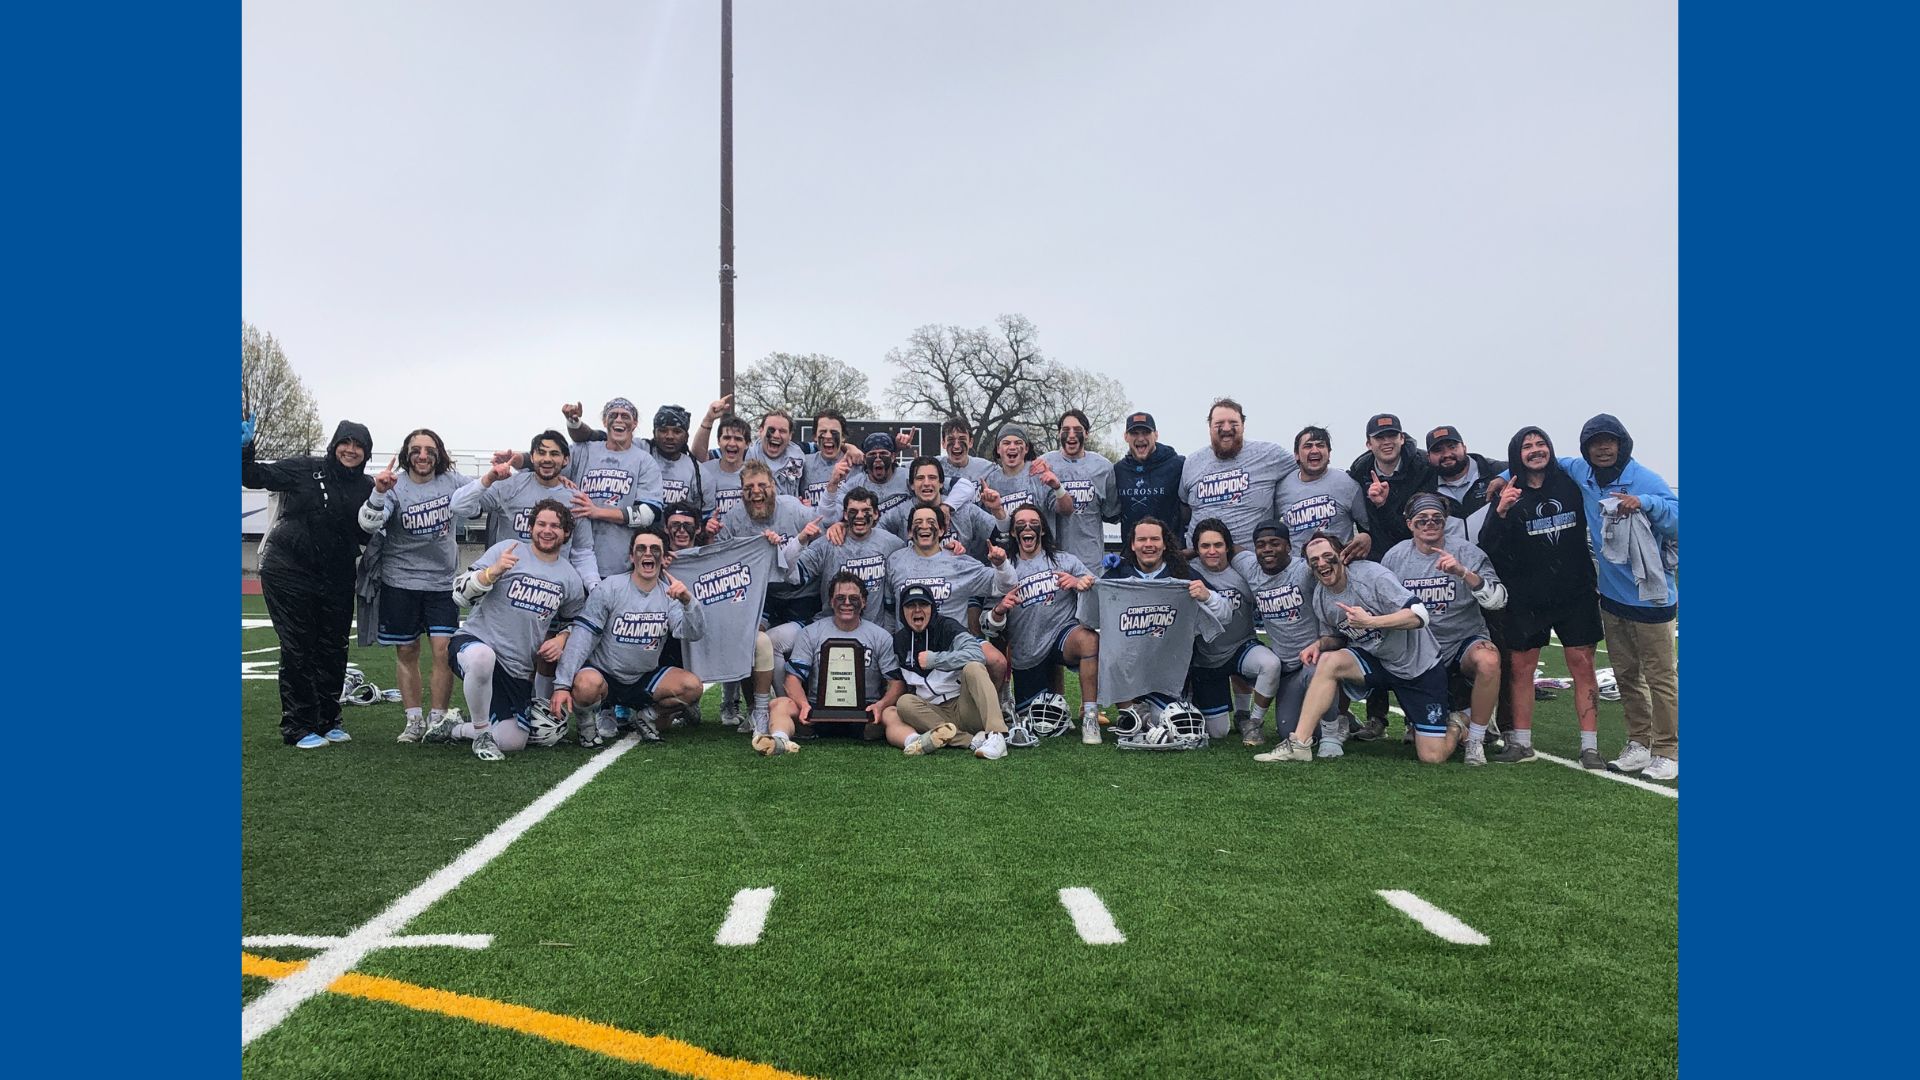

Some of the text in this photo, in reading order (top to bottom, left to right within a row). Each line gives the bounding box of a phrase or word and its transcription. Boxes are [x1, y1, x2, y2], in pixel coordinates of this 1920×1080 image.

[588, 469, 628, 478] CONFERENCE
[1203, 468, 1242, 482] CONFERENCE
[581, 476, 633, 495] CHAMPIONS
[1197, 473, 1249, 498] CHAMPIONS
[408, 495, 449, 514] CONFERENCE
[1204, 494, 1232, 503] 2022-23
[1291, 495, 1329, 510] CONFERENCE
[1287, 500, 1336, 525] CHAMPIONS
[847, 555, 883, 567] CONFERENCE
[700, 562, 741, 583] CONFERENCE
[522, 576, 562, 593] CONFERENCE
[694, 566, 750, 600] CHAMPIONS
[1403, 576, 1447, 588] CONFERENCE
[508, 580, 563, 610] CHAMPIONS
[705, 590, 736, 605] 2022-23
[1258, 583, 1292, 598] CONFERENCE
[513, 601, 545, 613] 2022-23
[1256, 587, 1303, 612] CHAMPIONS
[624, 612, 665, 621] CONFERENCE
[1128, 605, 1170, 615] CONFERENCE
[612, 617, 668, 637] CHAMPIONS
[1120, 610, 1176, 631] CHAMPIONS
